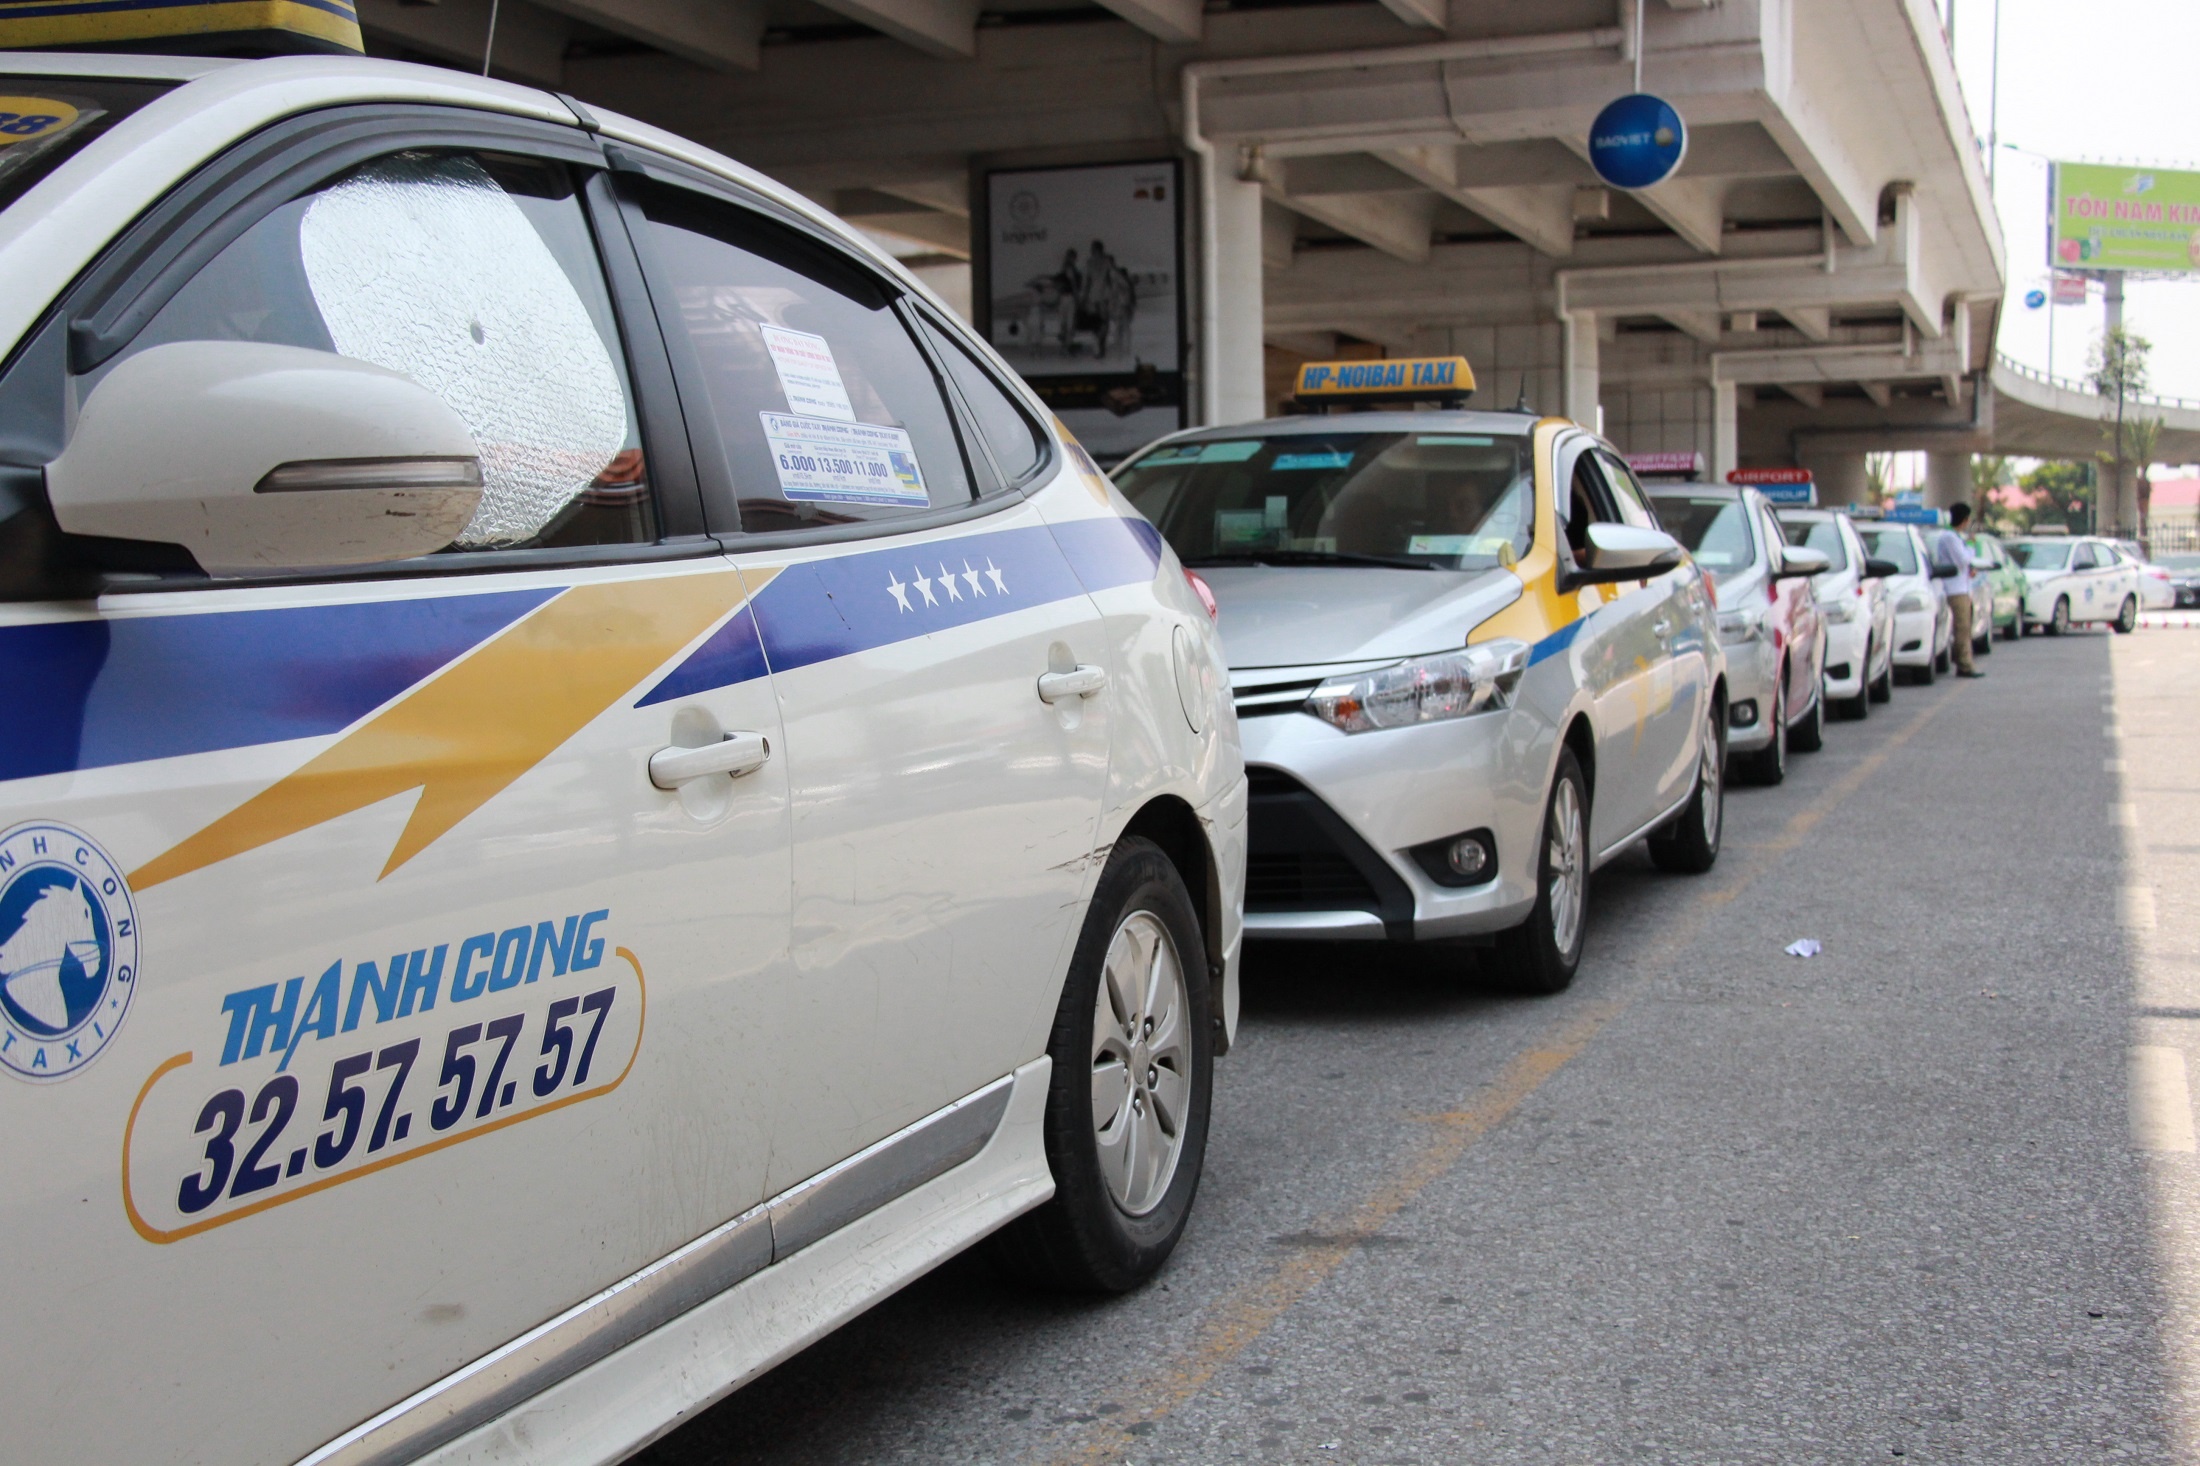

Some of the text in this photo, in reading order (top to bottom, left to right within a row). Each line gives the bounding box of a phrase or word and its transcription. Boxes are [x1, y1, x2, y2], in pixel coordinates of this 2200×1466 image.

[2066, 192, 2108, 218] TÔN
[2114, 200, 2163, 222] NAM
[1303, 361, 1456, 389] HP-NOIBAI TAXI
[779, 454, 888, 478] 6.000 13.500 11.000
[1732, 471, 1804, 483] AIRPORT
[449, 908, 610, 1002] CONG
